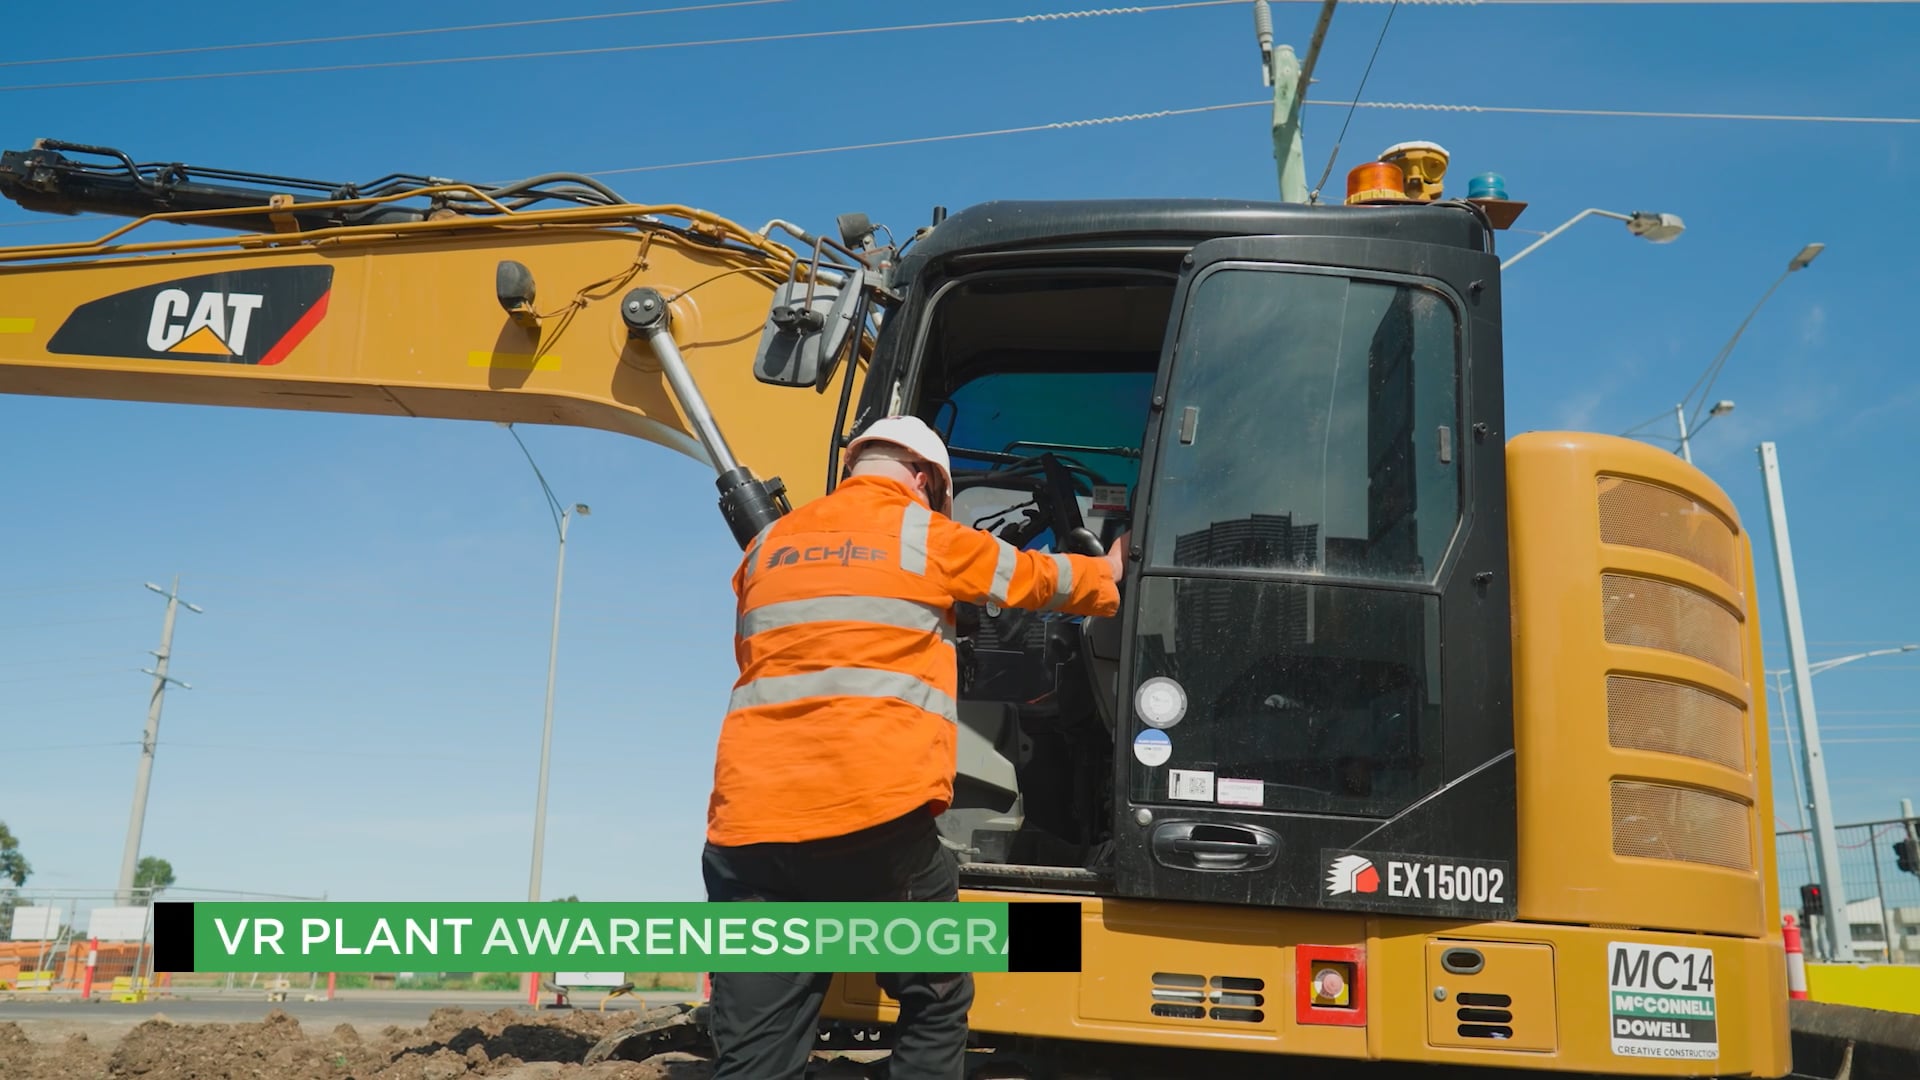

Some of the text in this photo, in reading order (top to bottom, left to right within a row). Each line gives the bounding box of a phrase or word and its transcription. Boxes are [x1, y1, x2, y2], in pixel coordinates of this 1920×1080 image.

[146, 288, 264, 357] CAT
[804, 539, 888, 566] CHIEF
[1387, 861, 1504, 904] EX15002
[1611, 947, 1714, 992] MC14
[1616, 1018, 1691, 1039] DOWELL
[1617, 1045, 1662, 1057] CREATIVE
